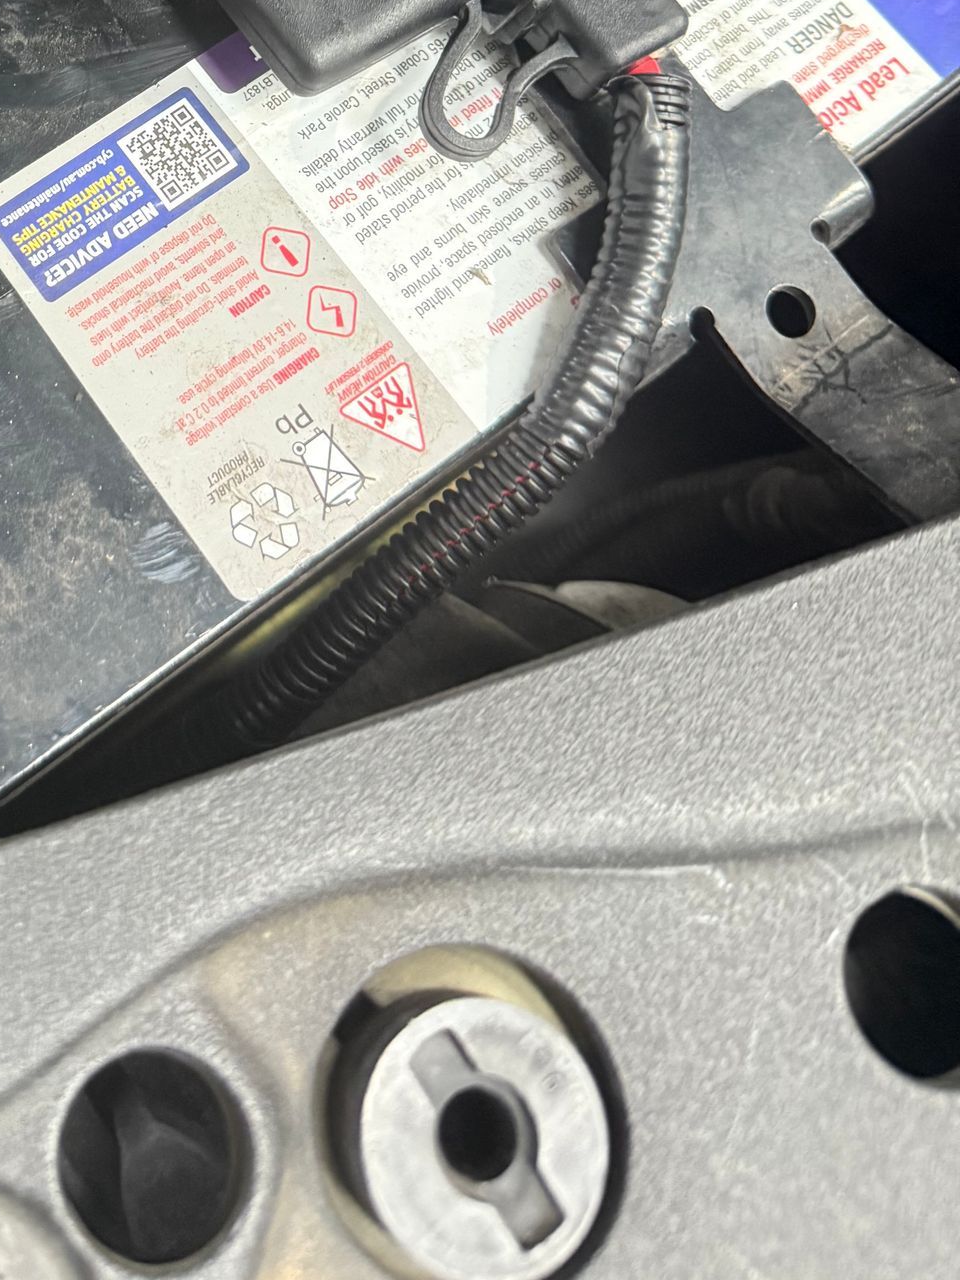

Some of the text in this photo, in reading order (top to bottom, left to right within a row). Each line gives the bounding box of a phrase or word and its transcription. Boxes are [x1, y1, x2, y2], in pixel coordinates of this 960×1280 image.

[678, 18, 721, 50] accident
[762, 17, 789, 39] away
[739, 37, 765, 56] from
[792, 24, 869, 83] discharged state
[393, 50, 429, 76] Cobalt
[702, 54, 742, 82] battery.
[357, 71, 396, 98] Street,
[814, 58, 909, 133] Lead Acid
[324, 96, 360, 122] Carole
[385, 104, 406, 122] full
[461, 95, 492, 120] fitted
[297, 118, 326, 140] Park
[338, 116, 387, 152] warranty
[362, 134, 398, 163] based
[386, 23, 749, 281] battery causes severe skin burns and eye
[414, 2, 853, 318] DANGER Lead acid Keep sparks, lighted
[513, 128, 561, 165] physician
[298, 148, 338, 178] details.
[333, 156, 363, 180] upon
[378, 155, 404, 176] with
[443, 166, 462, 182] for
[2, 150, 113, 226] cyb.com.au/maintenance
[356, 172, 380, 191] Idle
[378, 164, 425, 199] mobility,
[424, 177, 446, 194] the
[447, 164, 513, 211] immediately.
[488, 40, 885, 335] RECHARGE completely
[12, 164, 126, 245] & MAINTENANCE TIPS
[328, 186, 358, 210] Stop
[353, 194, 379, 219] golf
[389, 187, 426, 220] period
[20, 176, 135, 255] BATTERY CHARGING
[28, 186, 143, 266] SCAN THE CODE FOR
[355, 214, 391, 244] stated
[477, 208, 524, 246] enclosed
[45, 202, 158, 286] NEED ADVICE?
[440, 240, 477, 268] space,
[65, 231, 190, 318] dispose household waste.
[401, 264, 441, 298] provide
[78, 261, 177, 331] avoid mechanical shocks.
[90, 262, 207, 346] flame. contact fuels
[92, 256, 248, 367] terminals. discard battery onto
[229, 285, 270, 317] CAUTION
[134, 269, 259, 359] Avoid short-circuiting battery
[272, 331, 307, 358] charger,
[212, 348, 254, 378] following
[244, 355, 275, 381] current
[334, 355, 396, 402] CAUTION HEAVY
[176, 388, 195, 404] use.
[185, 348, 319, 446] CHARGING Use constant voltage
[192, 372, 217, 393] cycle
[217, 376, 247, 401] limited
[275, 404, 313, 437] Pb
[207, 450, 249, 487] PRODUCT
[207, 456, 265, 504] RECYCLABLE
